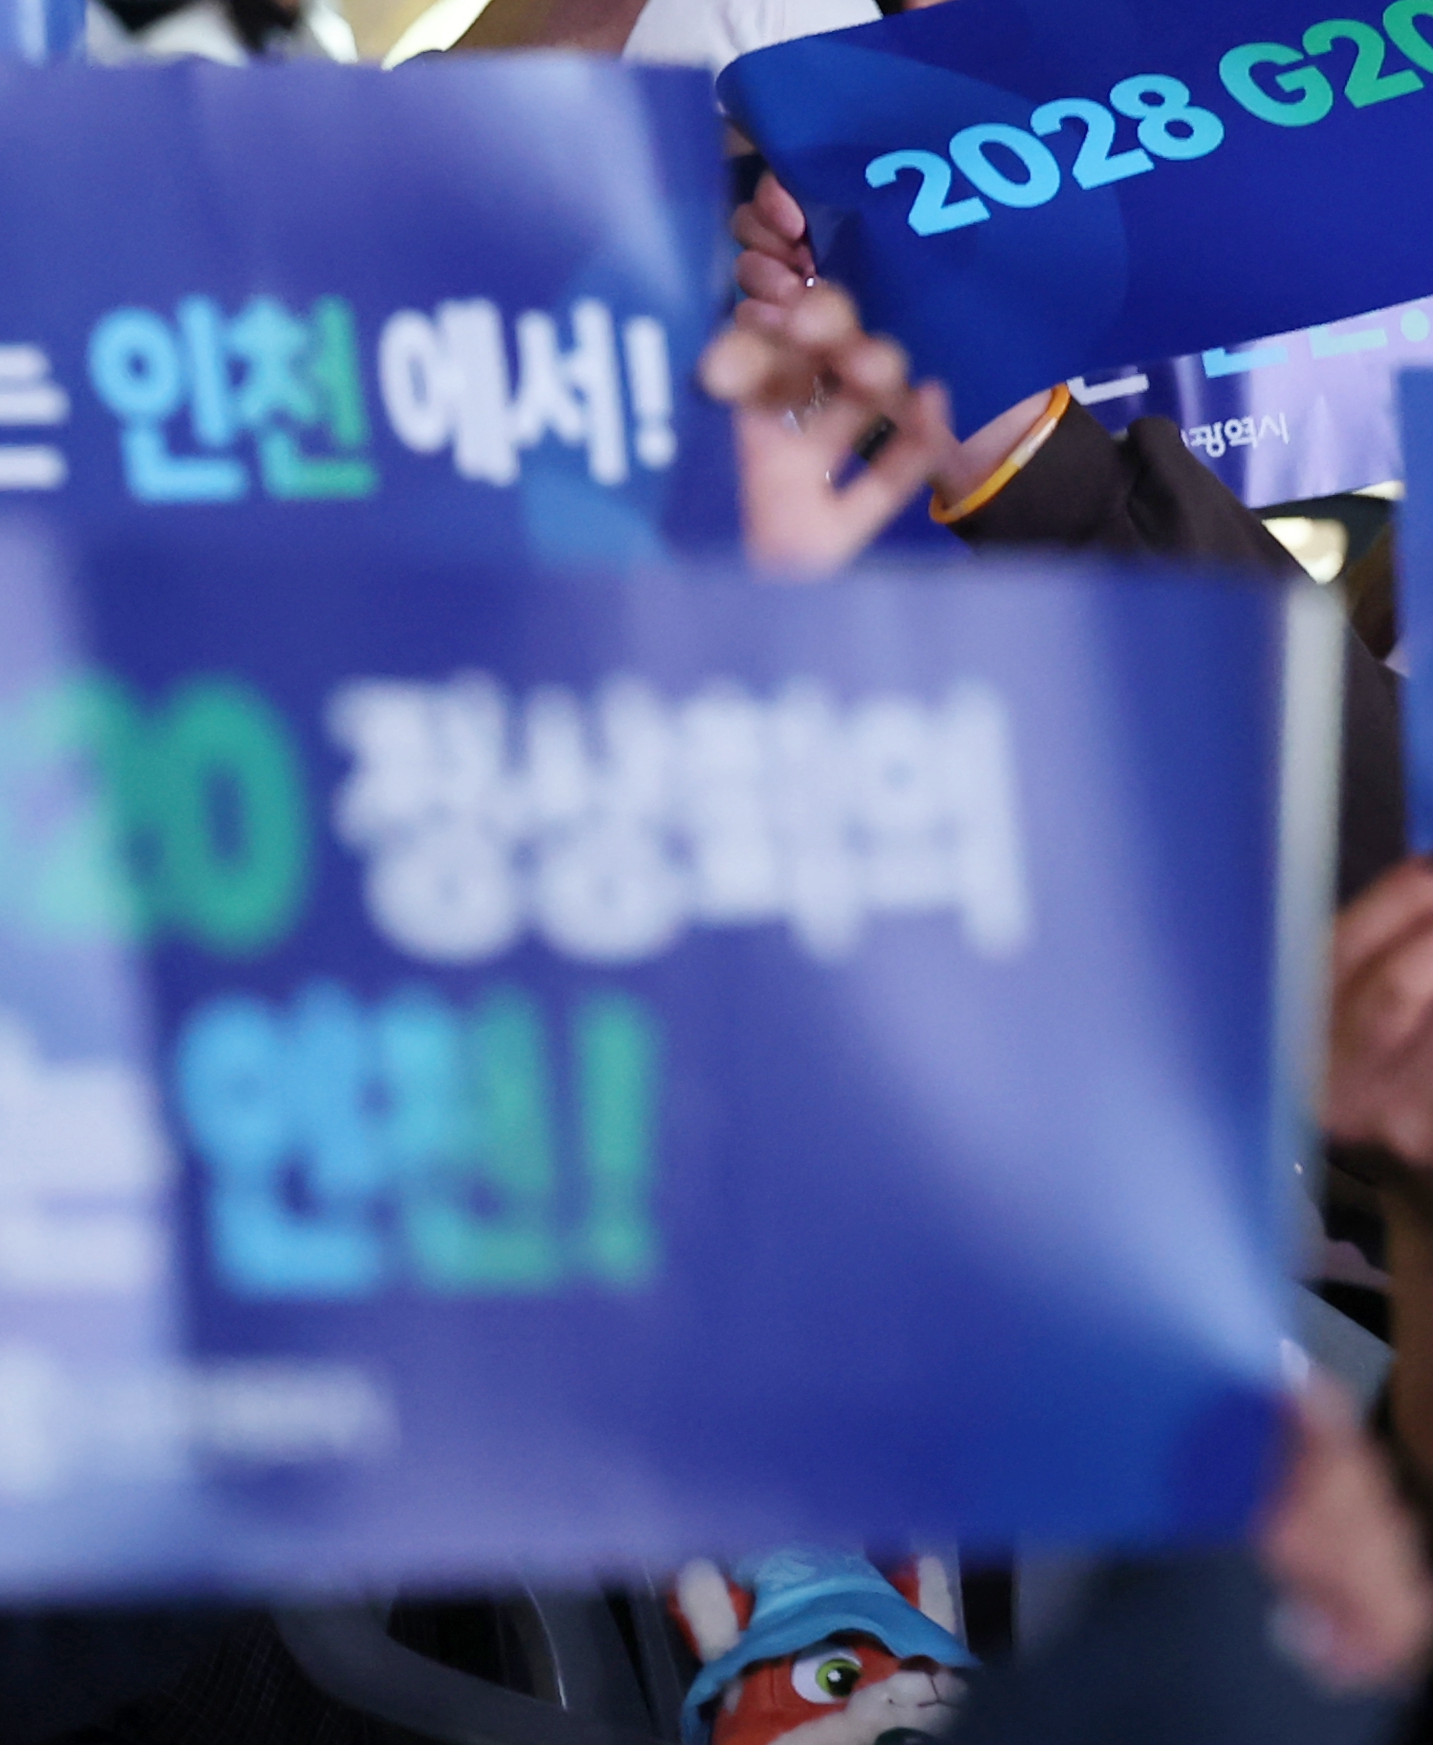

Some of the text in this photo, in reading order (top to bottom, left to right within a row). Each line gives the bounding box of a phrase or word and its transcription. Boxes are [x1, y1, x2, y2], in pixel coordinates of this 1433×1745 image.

[866, 75, 1224, 236] 2028
[88, 295, 378, 502] 인천
[380, 300, 675, 485] 에서!
[1181, 412, 1290, 458] 광역시
[336, 668, 1038, 964] 정상회의
